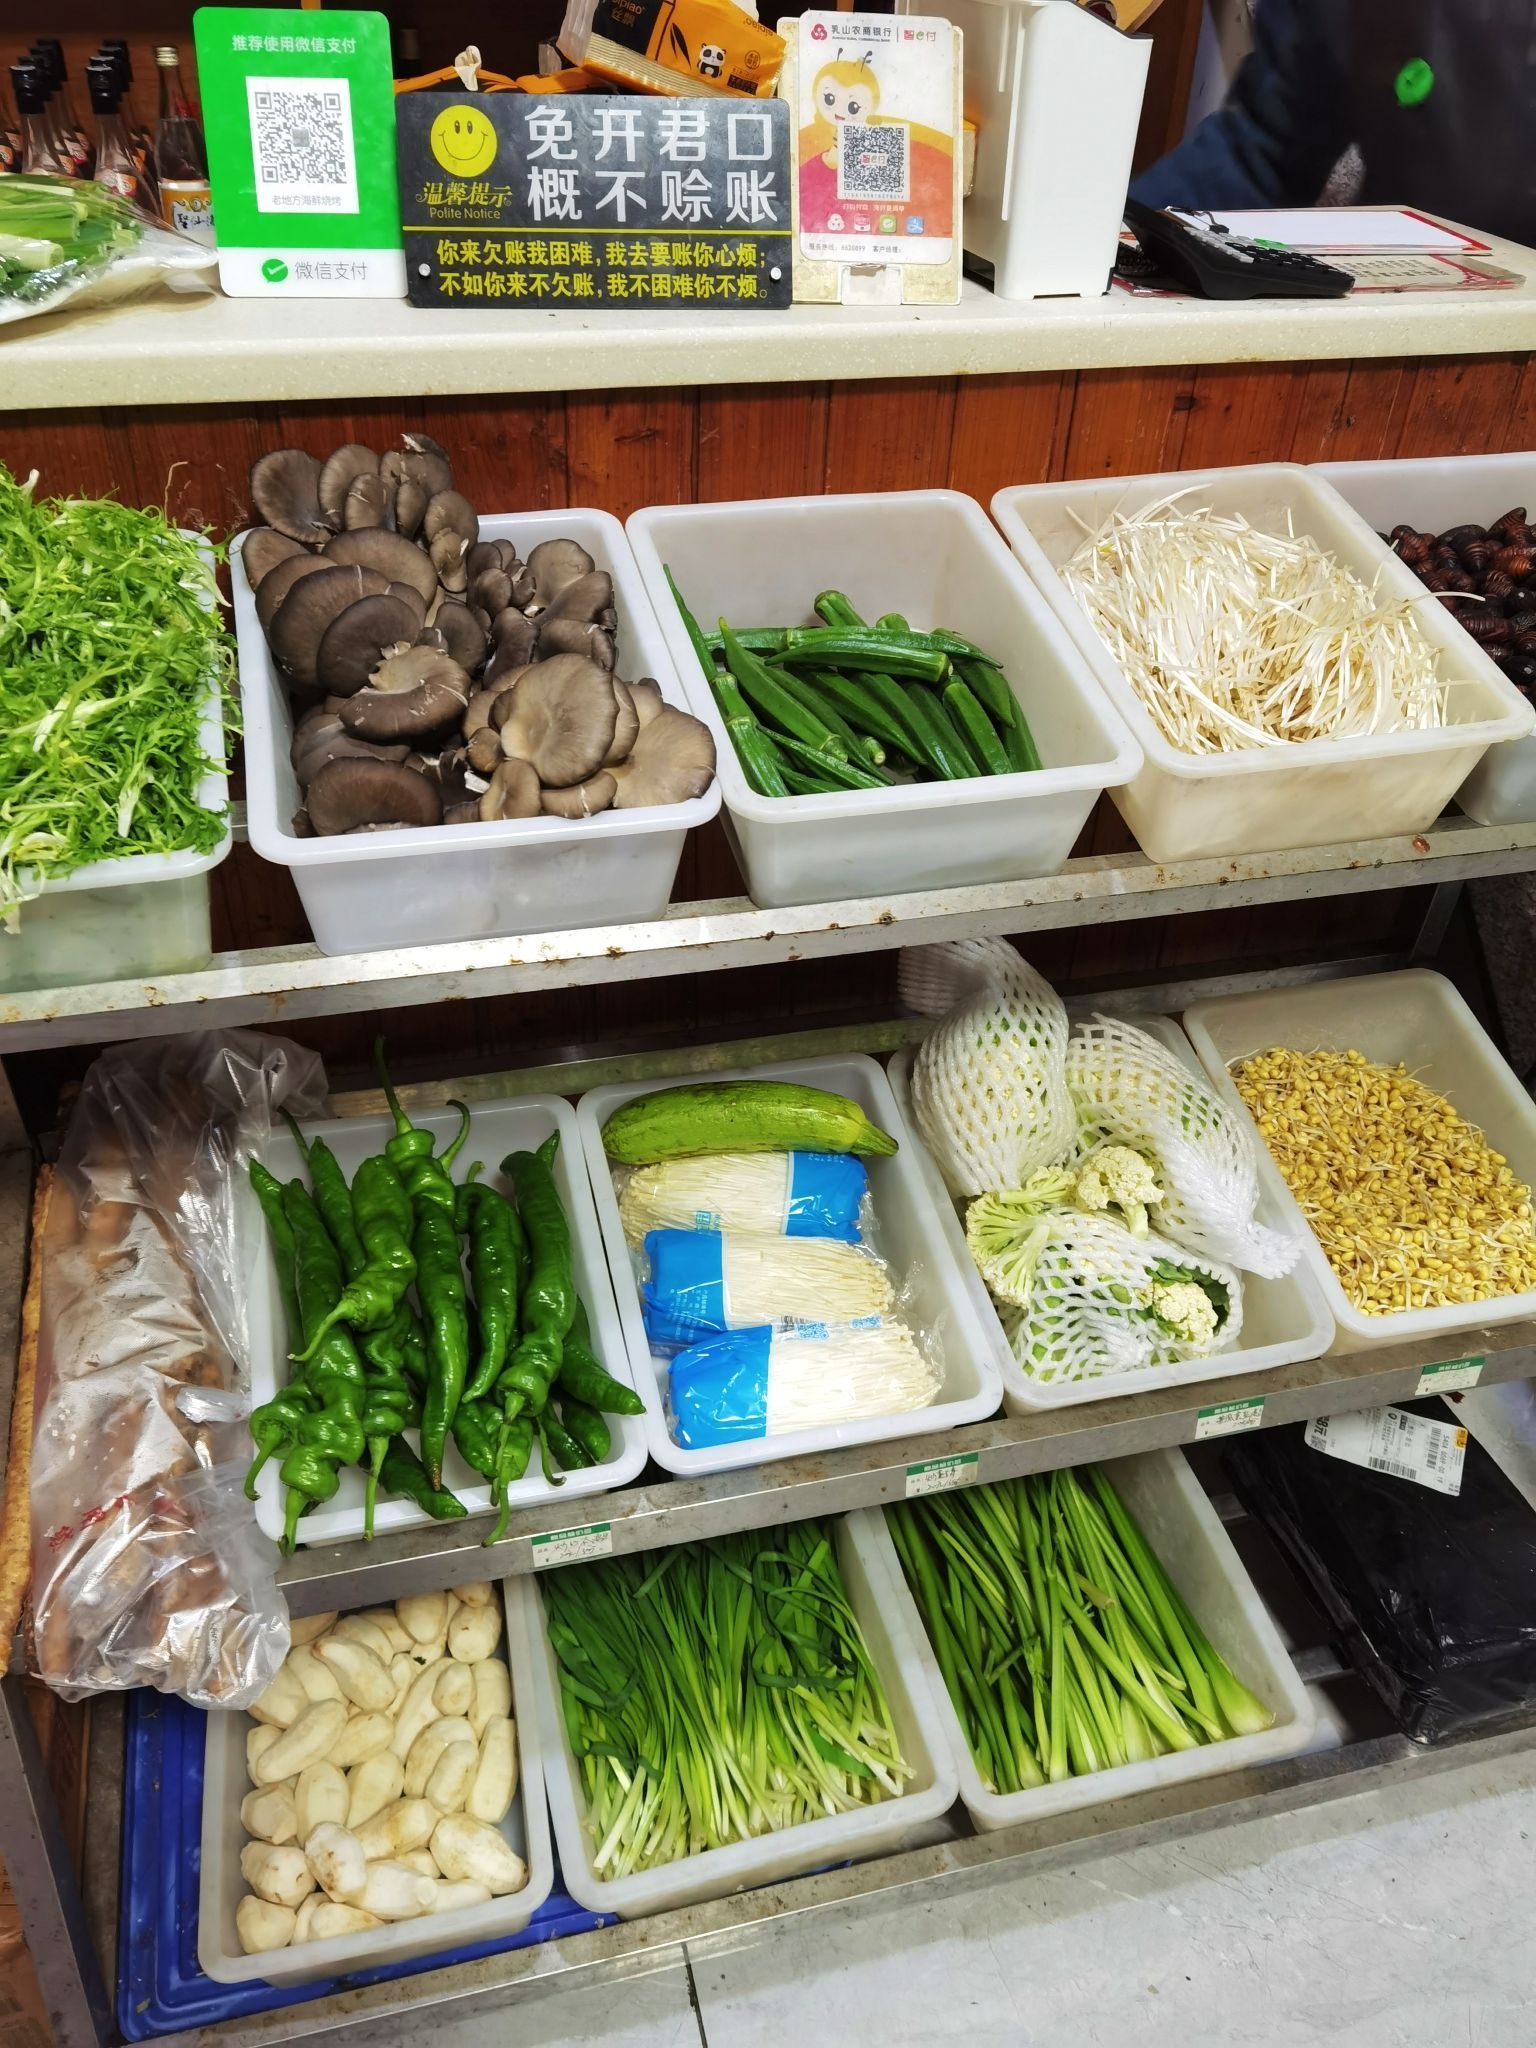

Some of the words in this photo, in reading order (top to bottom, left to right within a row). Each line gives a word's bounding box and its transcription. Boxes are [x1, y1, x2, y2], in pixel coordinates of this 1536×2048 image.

[831, 24, 892, 37] 乳山农商银行
[232, 34, 357, 54] 推荐使用微信支付
[524, 107, 774, 162] 免开君口
[271, 194, 342, 207] 老地方海鲜烧烤
[416, 181, 512, 208] 温馨提示
[526, 169, 778, 223] 概不赊账
[429, 207, 462, 219] Polite
[464, 207, 501, 219] Notice
[294, 260, 368, 281] 微信支付
